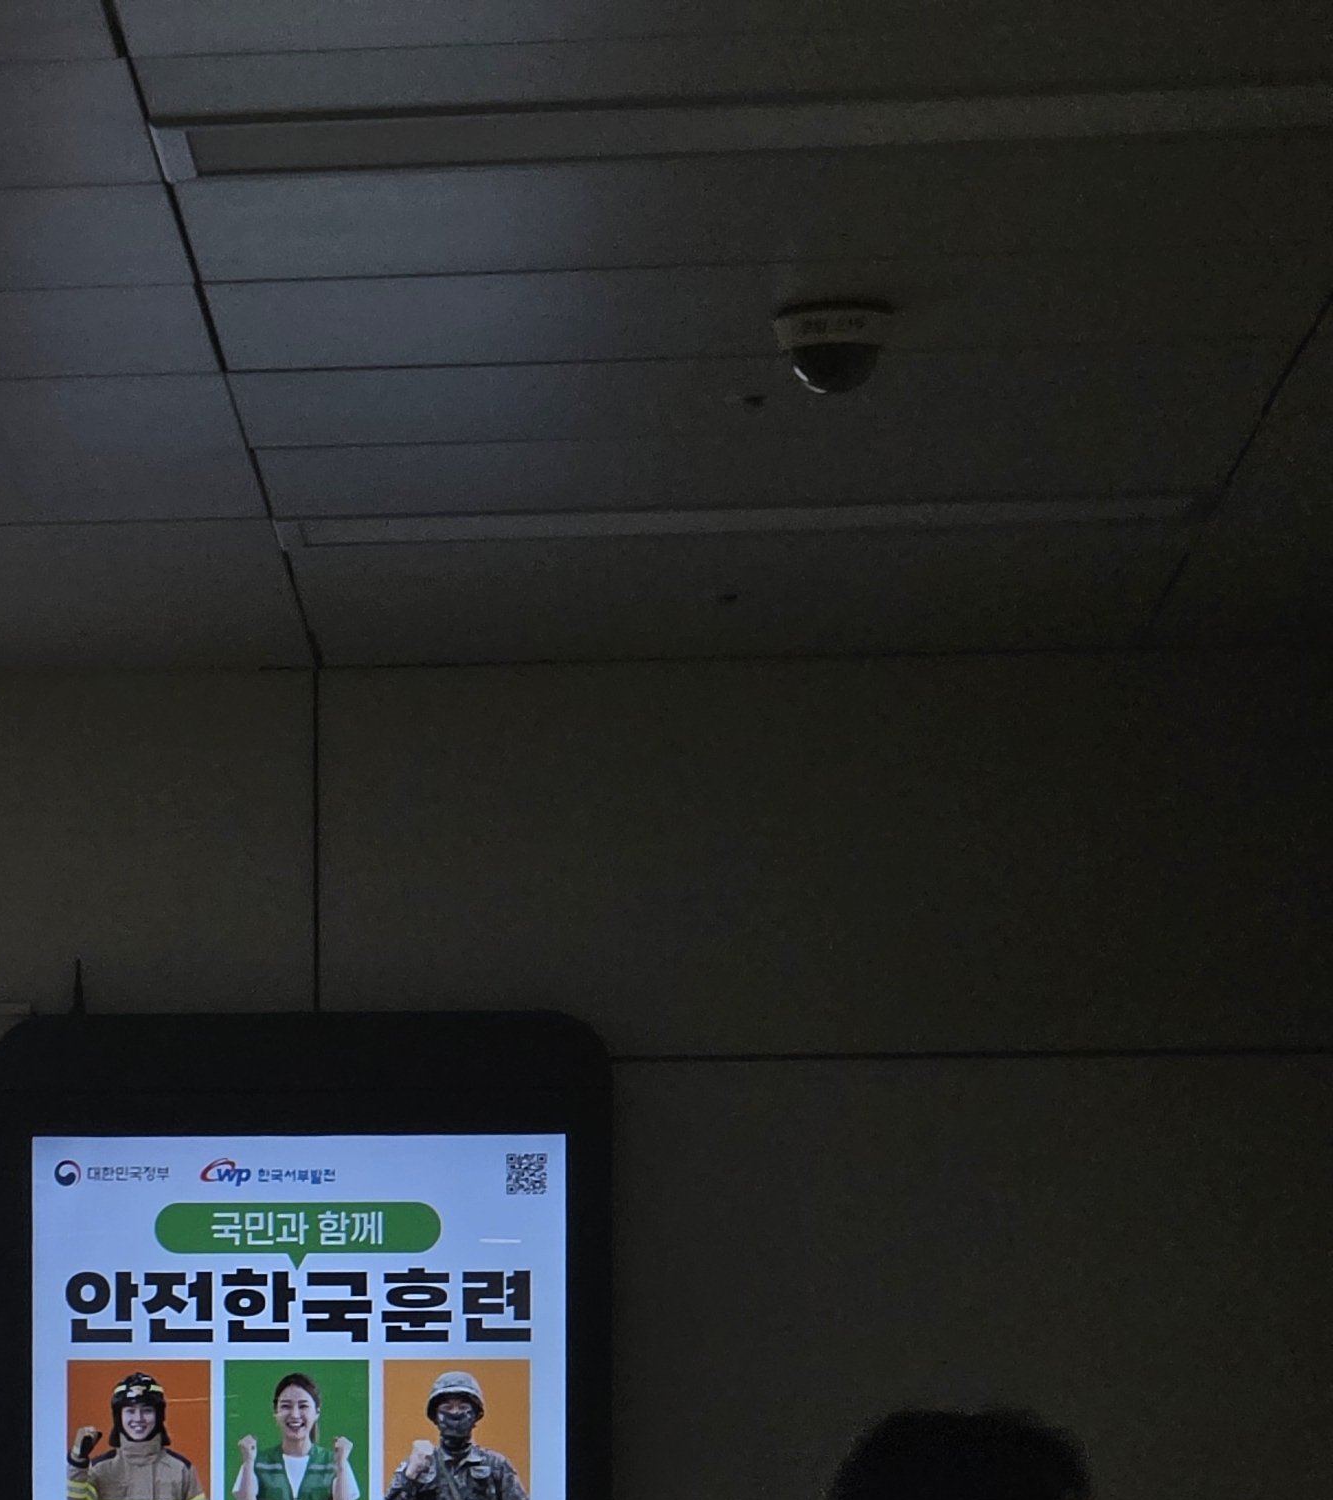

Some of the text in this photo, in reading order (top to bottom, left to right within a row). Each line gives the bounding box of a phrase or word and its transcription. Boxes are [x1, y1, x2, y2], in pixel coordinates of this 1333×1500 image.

[88, 1165, 170, 1183] 대한민국정부
[258, 1168, 336, 1185] 한국서부발전
[210, 1211, 383, 1247] 국민과 함께
[65, 1268, 532, 1343] 안전한국훈련
